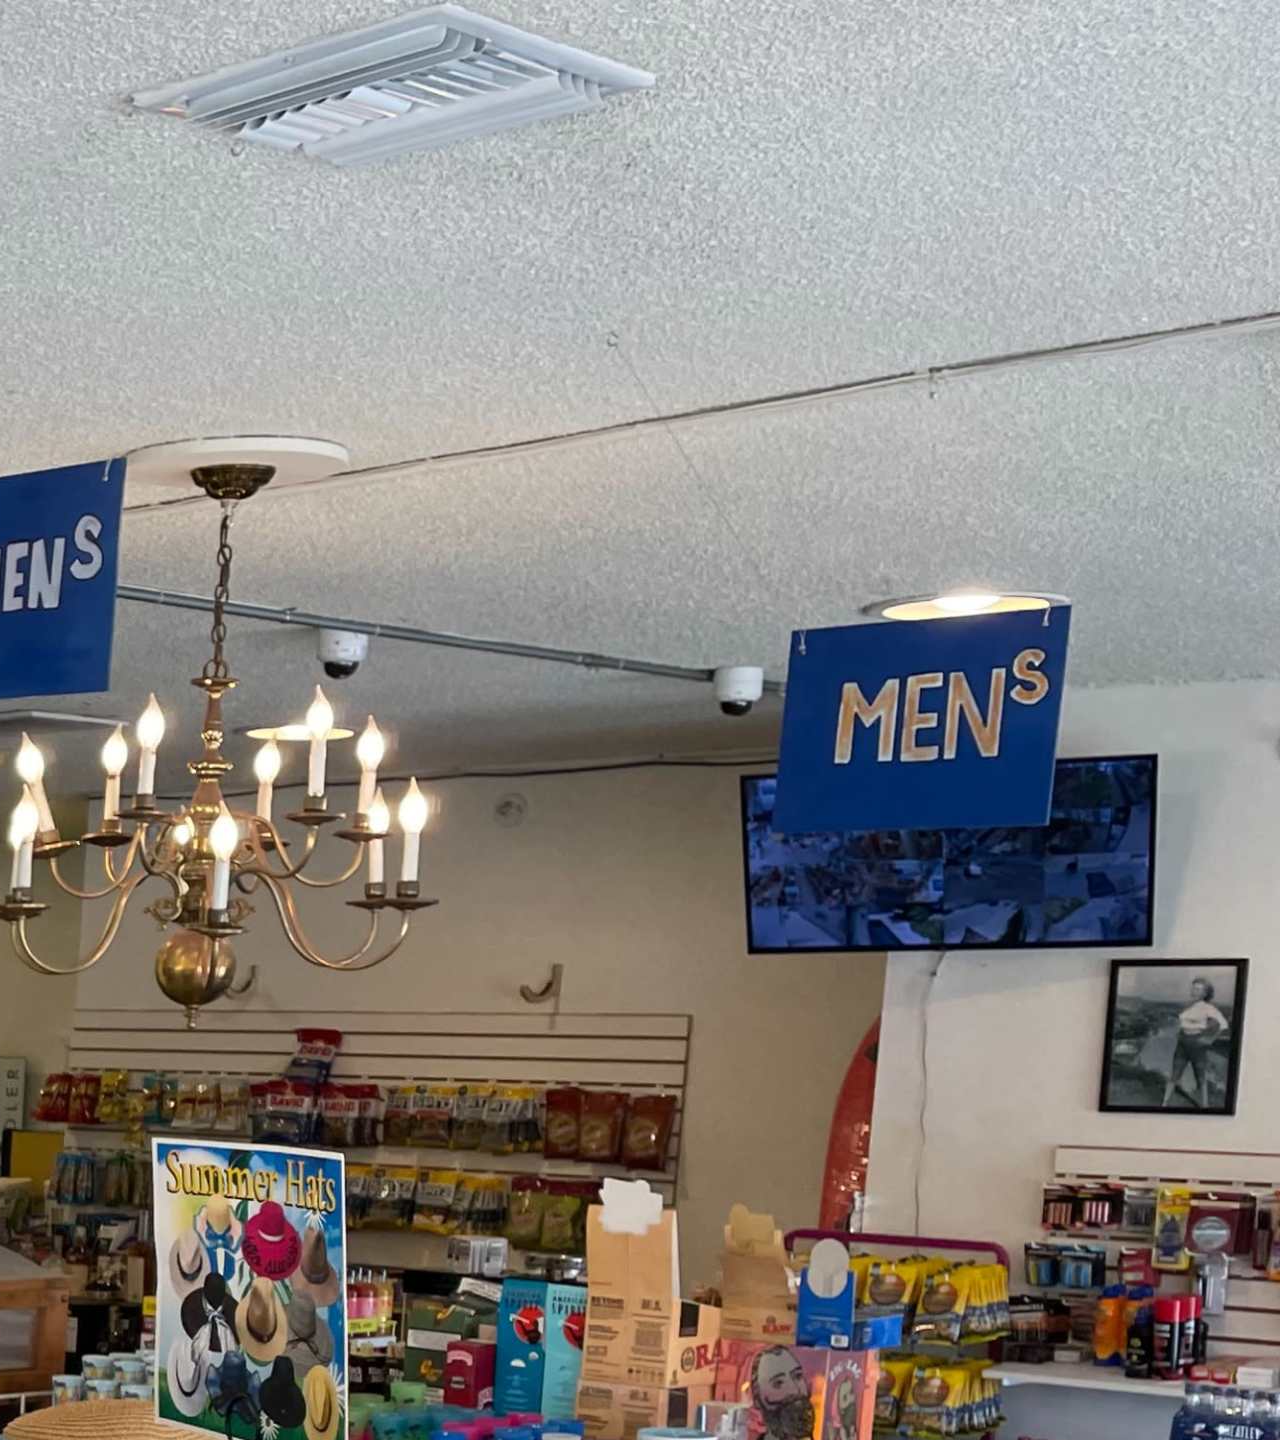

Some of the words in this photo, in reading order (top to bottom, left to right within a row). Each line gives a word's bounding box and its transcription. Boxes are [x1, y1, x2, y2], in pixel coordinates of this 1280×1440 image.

[833, 648, 1050, 765] MENS
[165, 1149, 280, 1202] Summer
[284, 1158, 337, 1213] Hats
